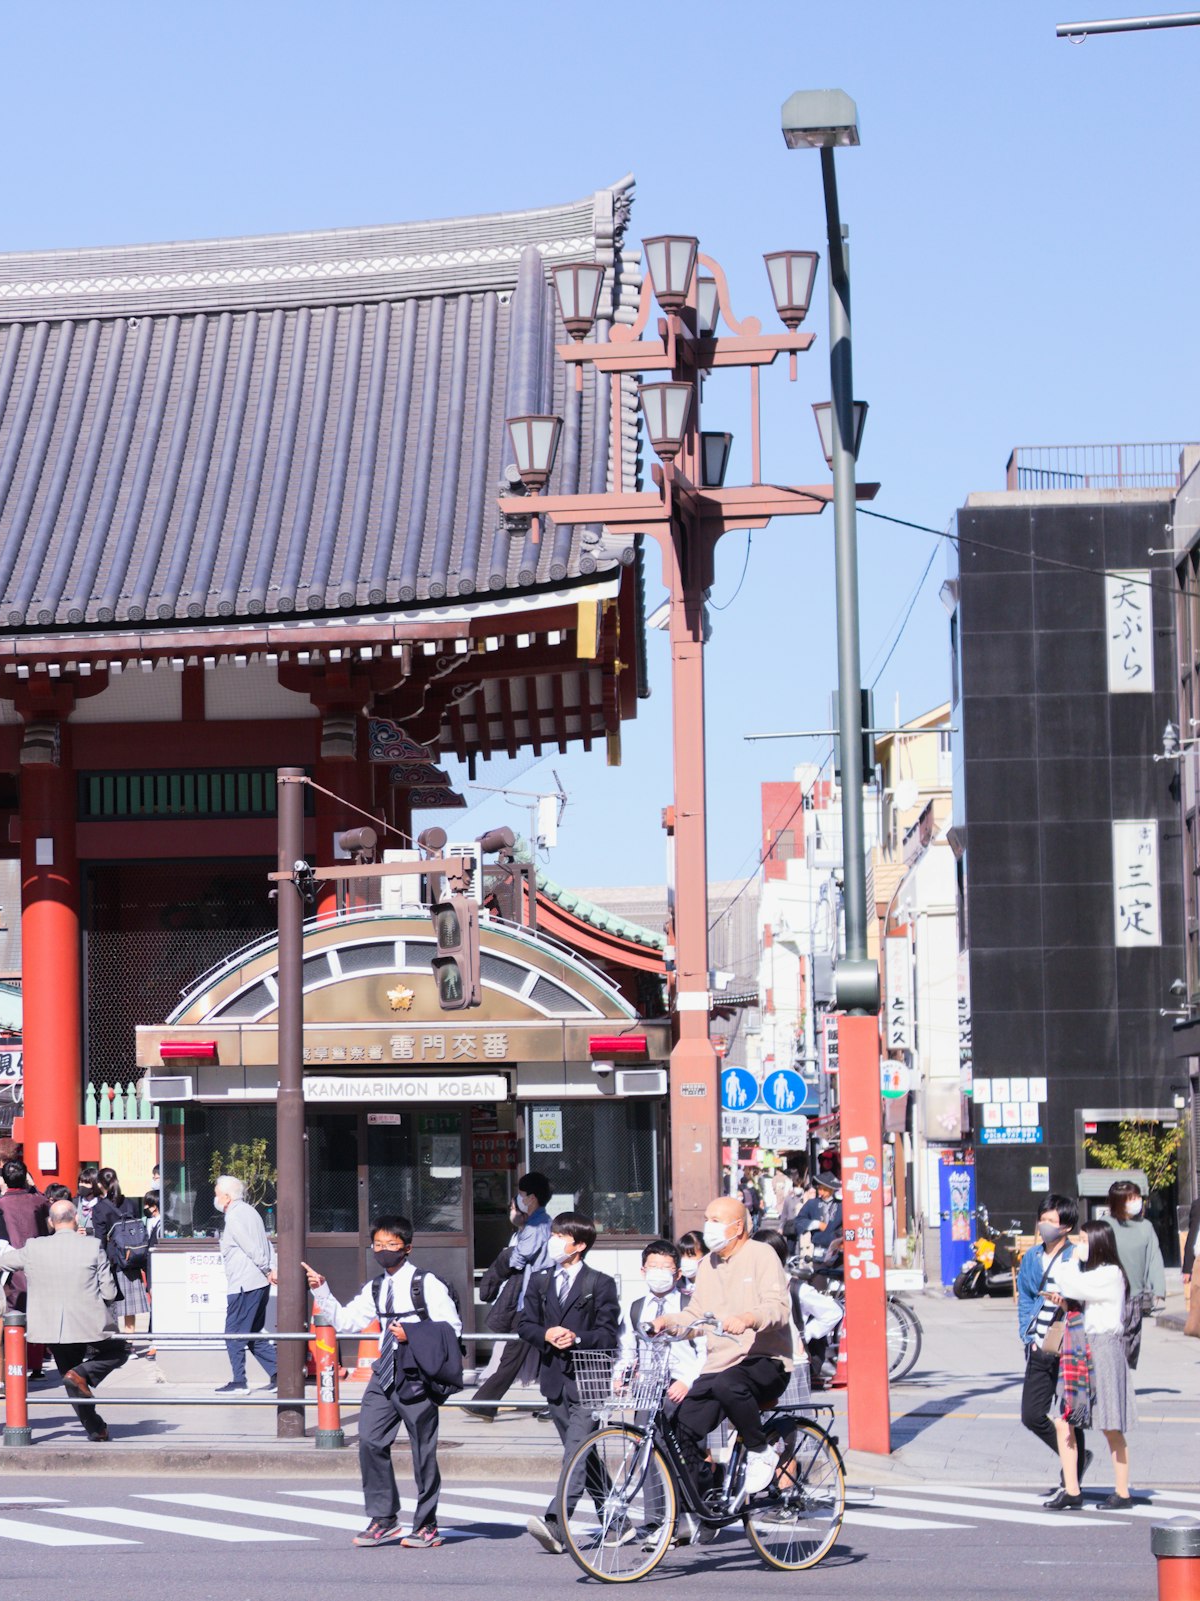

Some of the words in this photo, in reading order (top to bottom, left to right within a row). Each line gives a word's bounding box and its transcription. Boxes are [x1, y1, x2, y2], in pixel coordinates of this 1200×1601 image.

[1112, 583, 1142, 680] 天ぷら
[1138, 827, 1152, 855] 雷門
[1119, 865, 1153, 935] 三定
[389, 1033, 509, 1060] 雷門交番
[307, 1082, 428, 1097] KAMINARIMON
[438, 1082, 495, 1096] KOBAN
[721, 1125, 754, 1134] 見世通り
[8, 1365, 23, 1376] 24K
